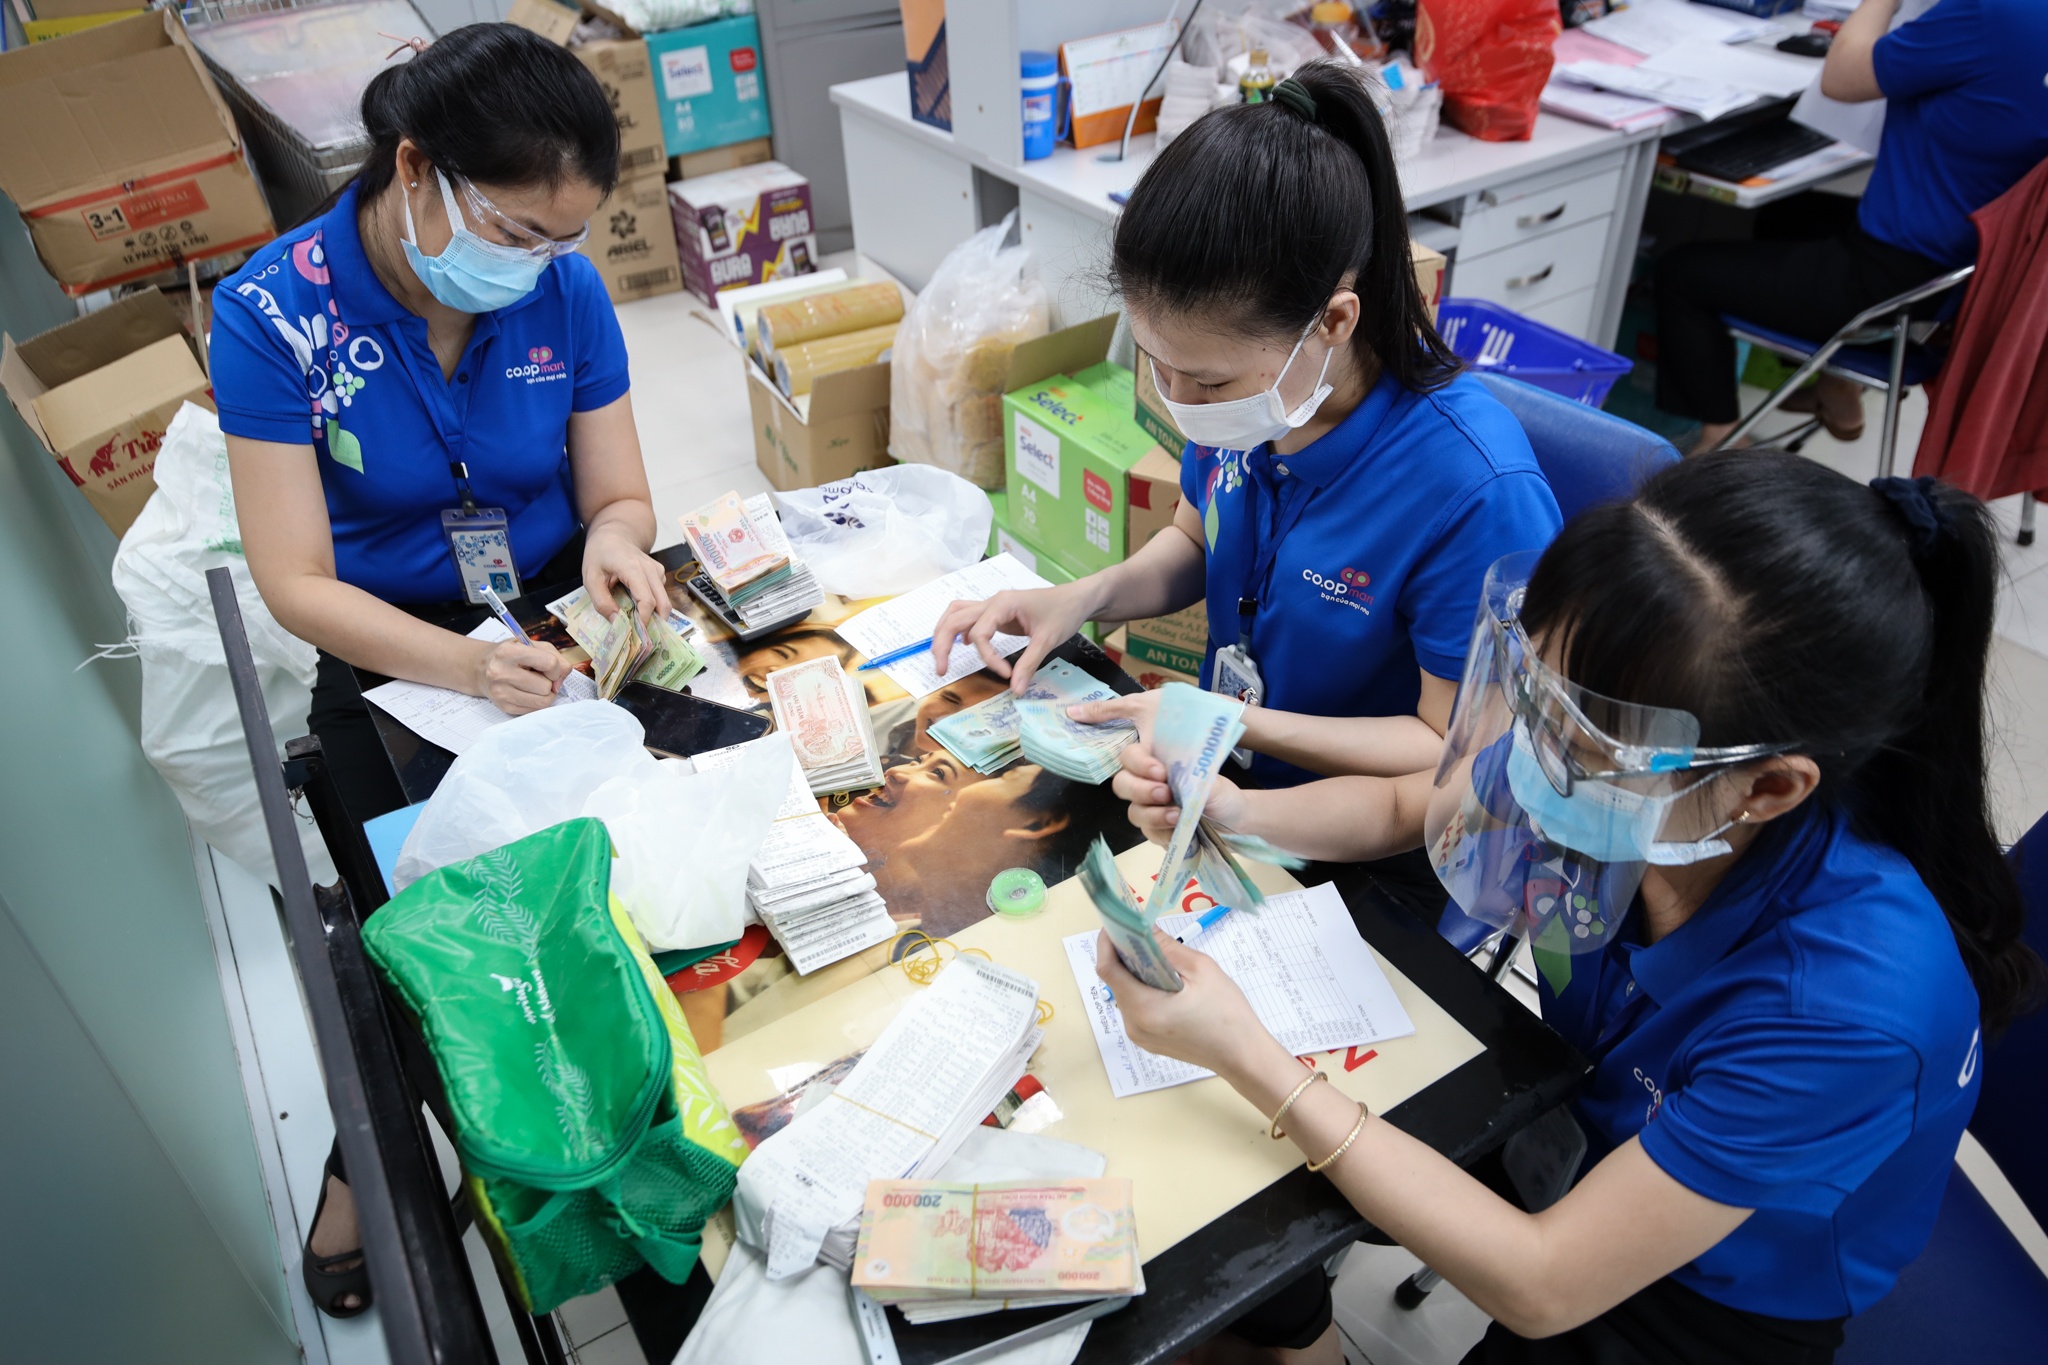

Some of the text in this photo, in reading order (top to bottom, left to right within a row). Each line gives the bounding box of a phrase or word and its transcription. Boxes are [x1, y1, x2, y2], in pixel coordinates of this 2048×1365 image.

[1028, 391, 1084, 427] Select
[1020, 435, 1055, 470] Select
[1021, 483, 1037, 503] A4
[1023, 505, 1037, 525] 70
[1146, 648, 1168, 664] AN
[792, 694, 804, 720] HAI TRĂM
[1087, 984, 1099, 1000] TIỀN
